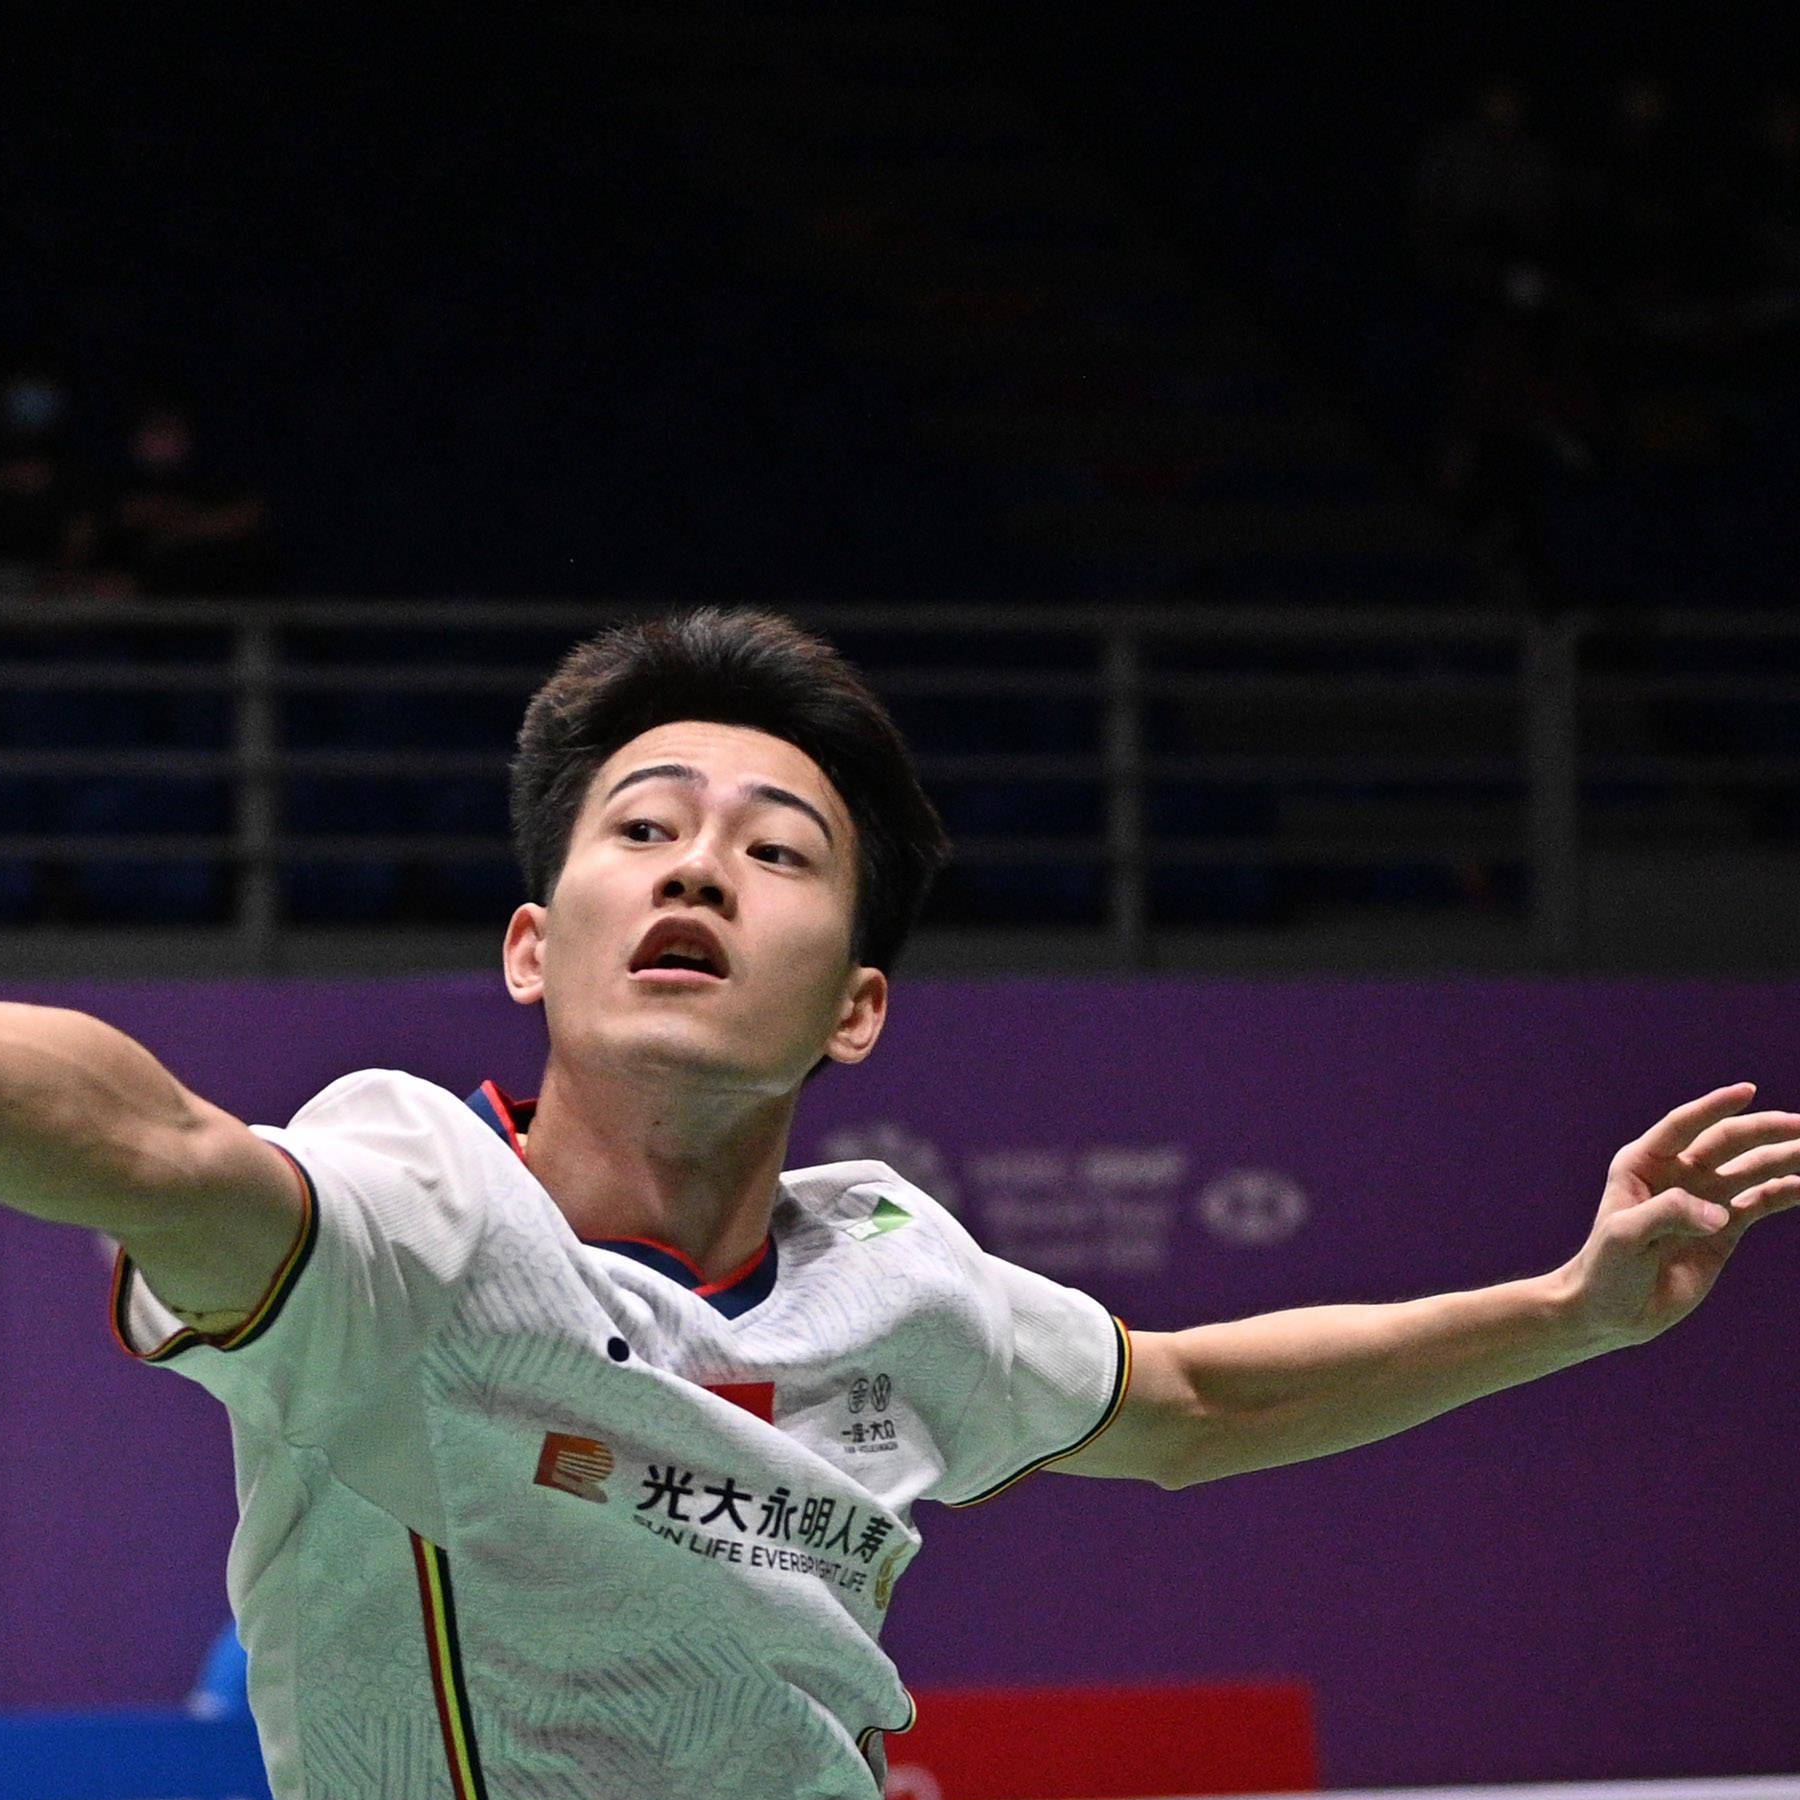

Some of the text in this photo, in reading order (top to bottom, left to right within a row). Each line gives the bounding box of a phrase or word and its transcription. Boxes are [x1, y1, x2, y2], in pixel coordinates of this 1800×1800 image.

[636, 1463, 894, 1565] 光大永明人寿
[688, 1532, 744, 1564] LIFE
[751, 1547, 841, 1588] EVERBRIGHT
